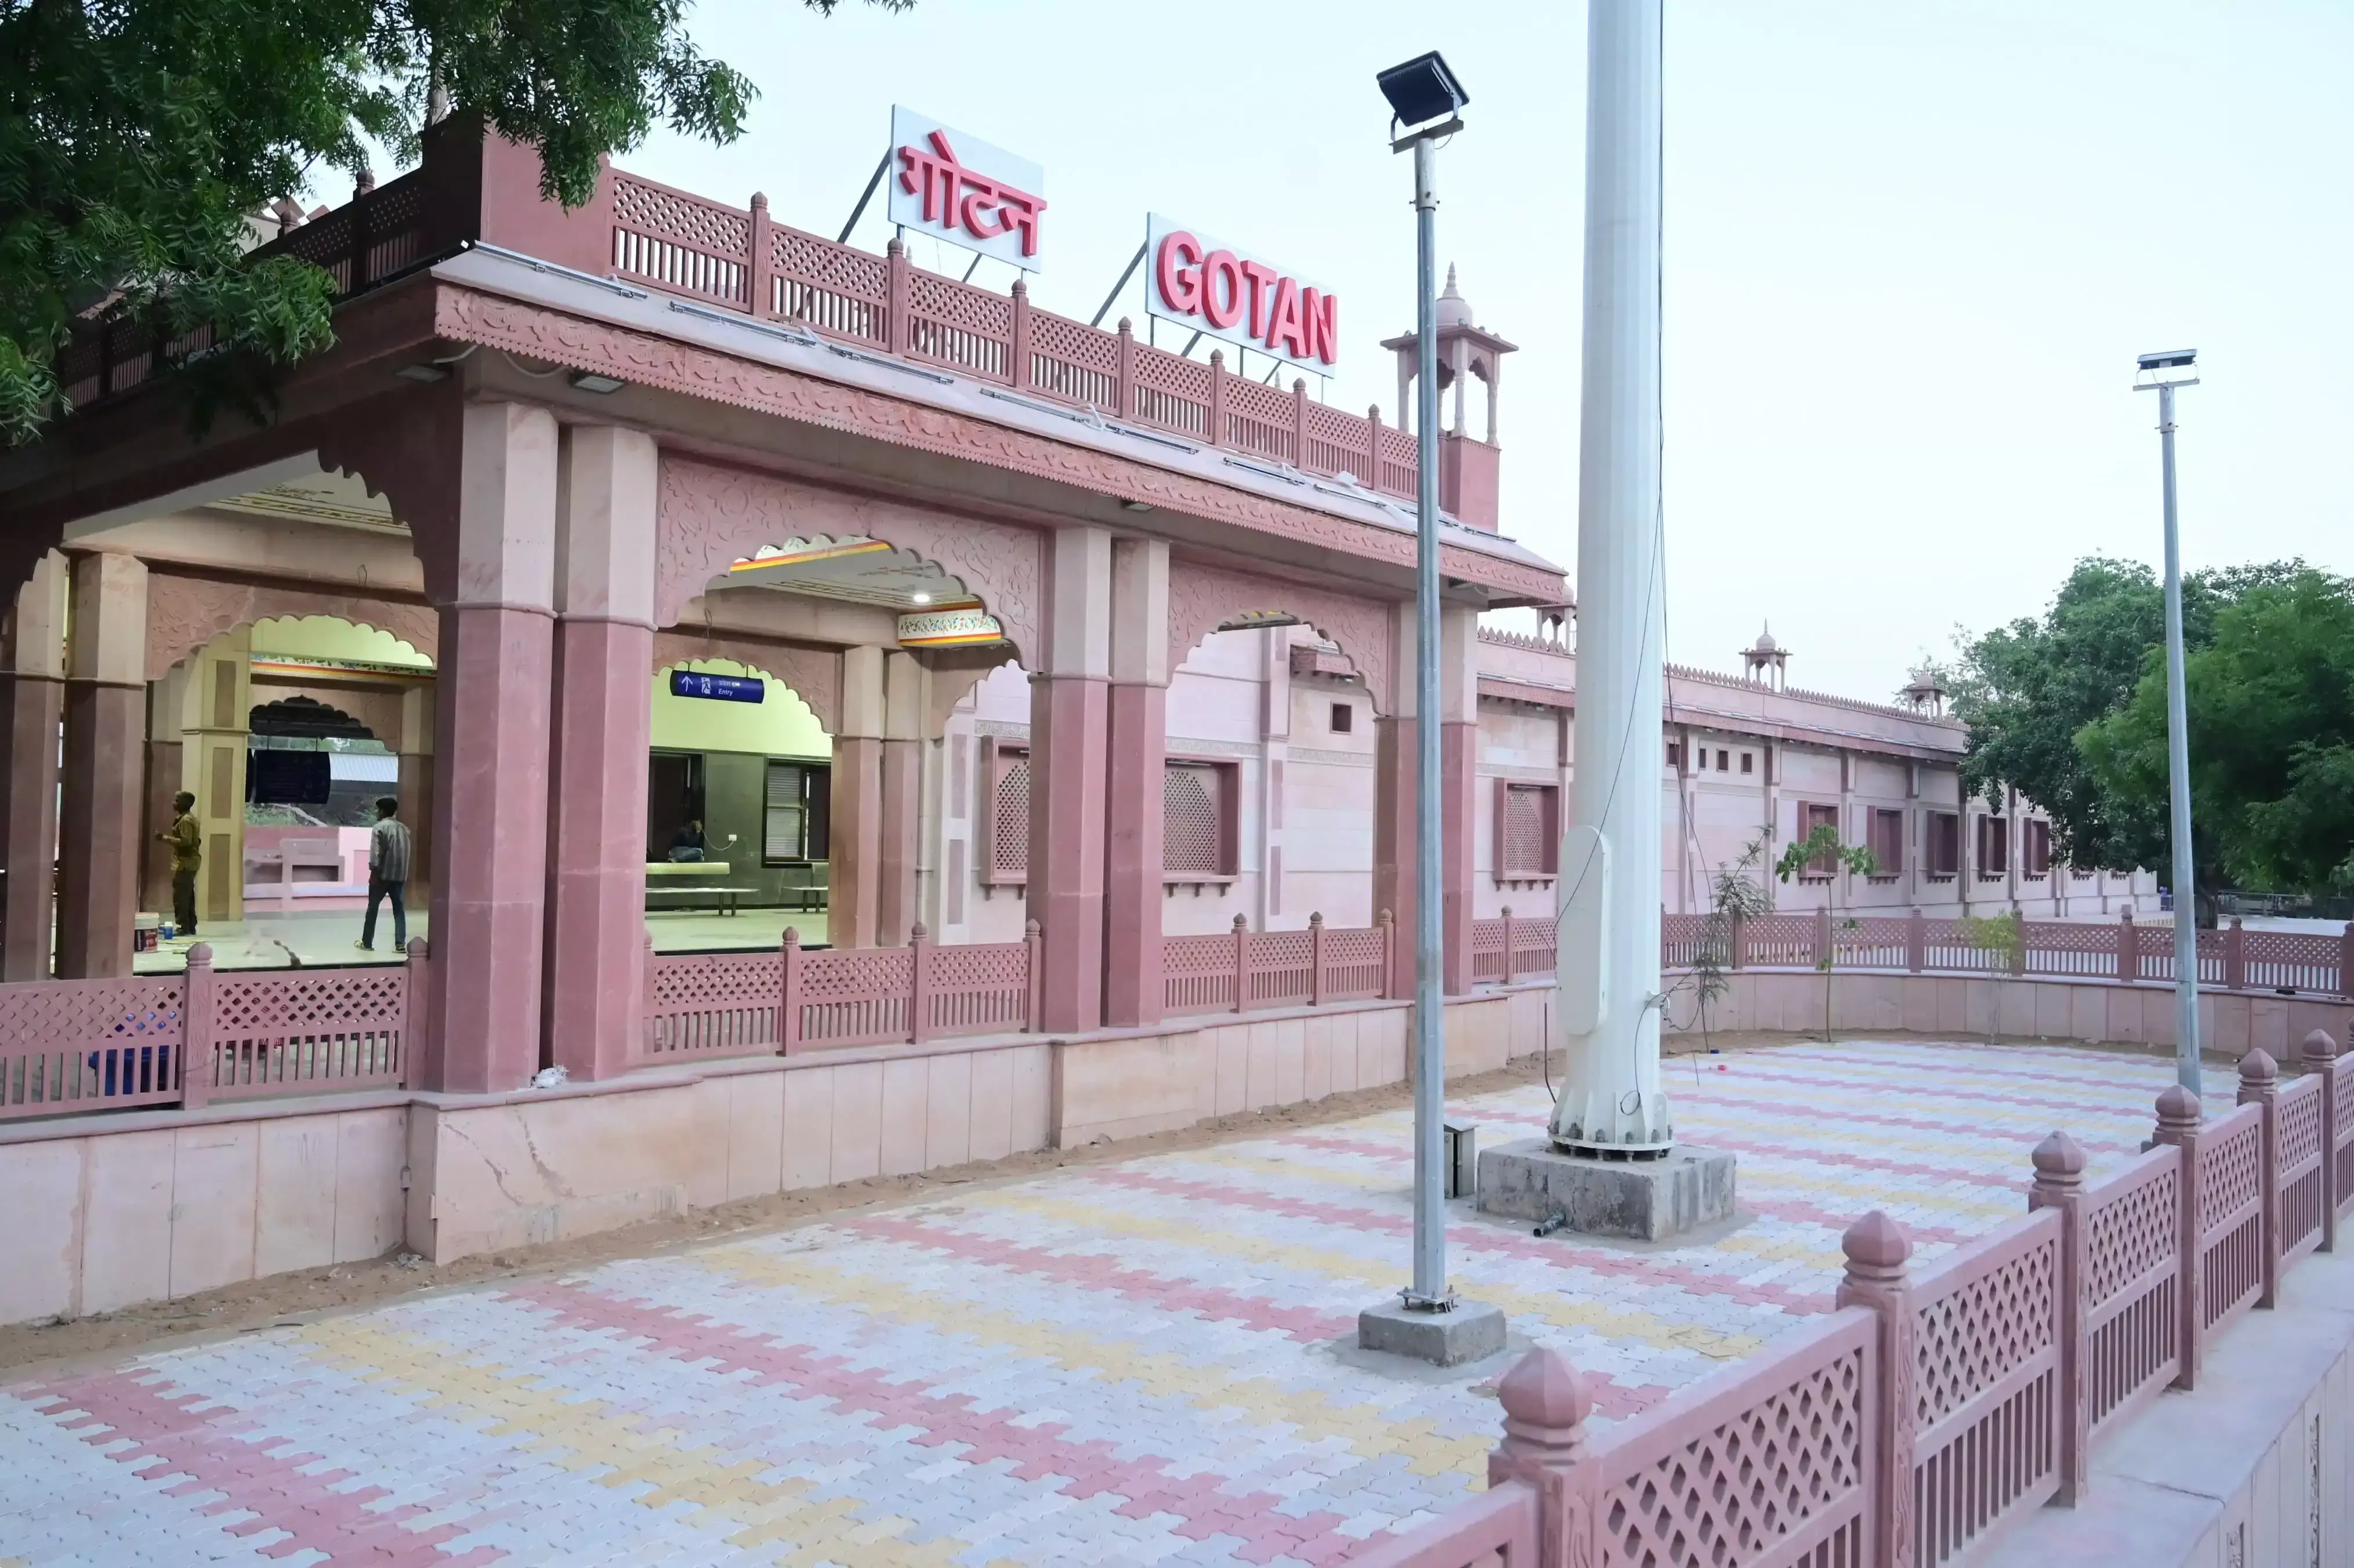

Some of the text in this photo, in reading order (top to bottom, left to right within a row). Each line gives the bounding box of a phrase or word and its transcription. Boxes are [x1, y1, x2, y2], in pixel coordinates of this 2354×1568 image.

[898, 129, 1047, 257] गोटन
[1157, 231, 1337, 364] GOTAN
[718, 688, 733, 696] Entry
